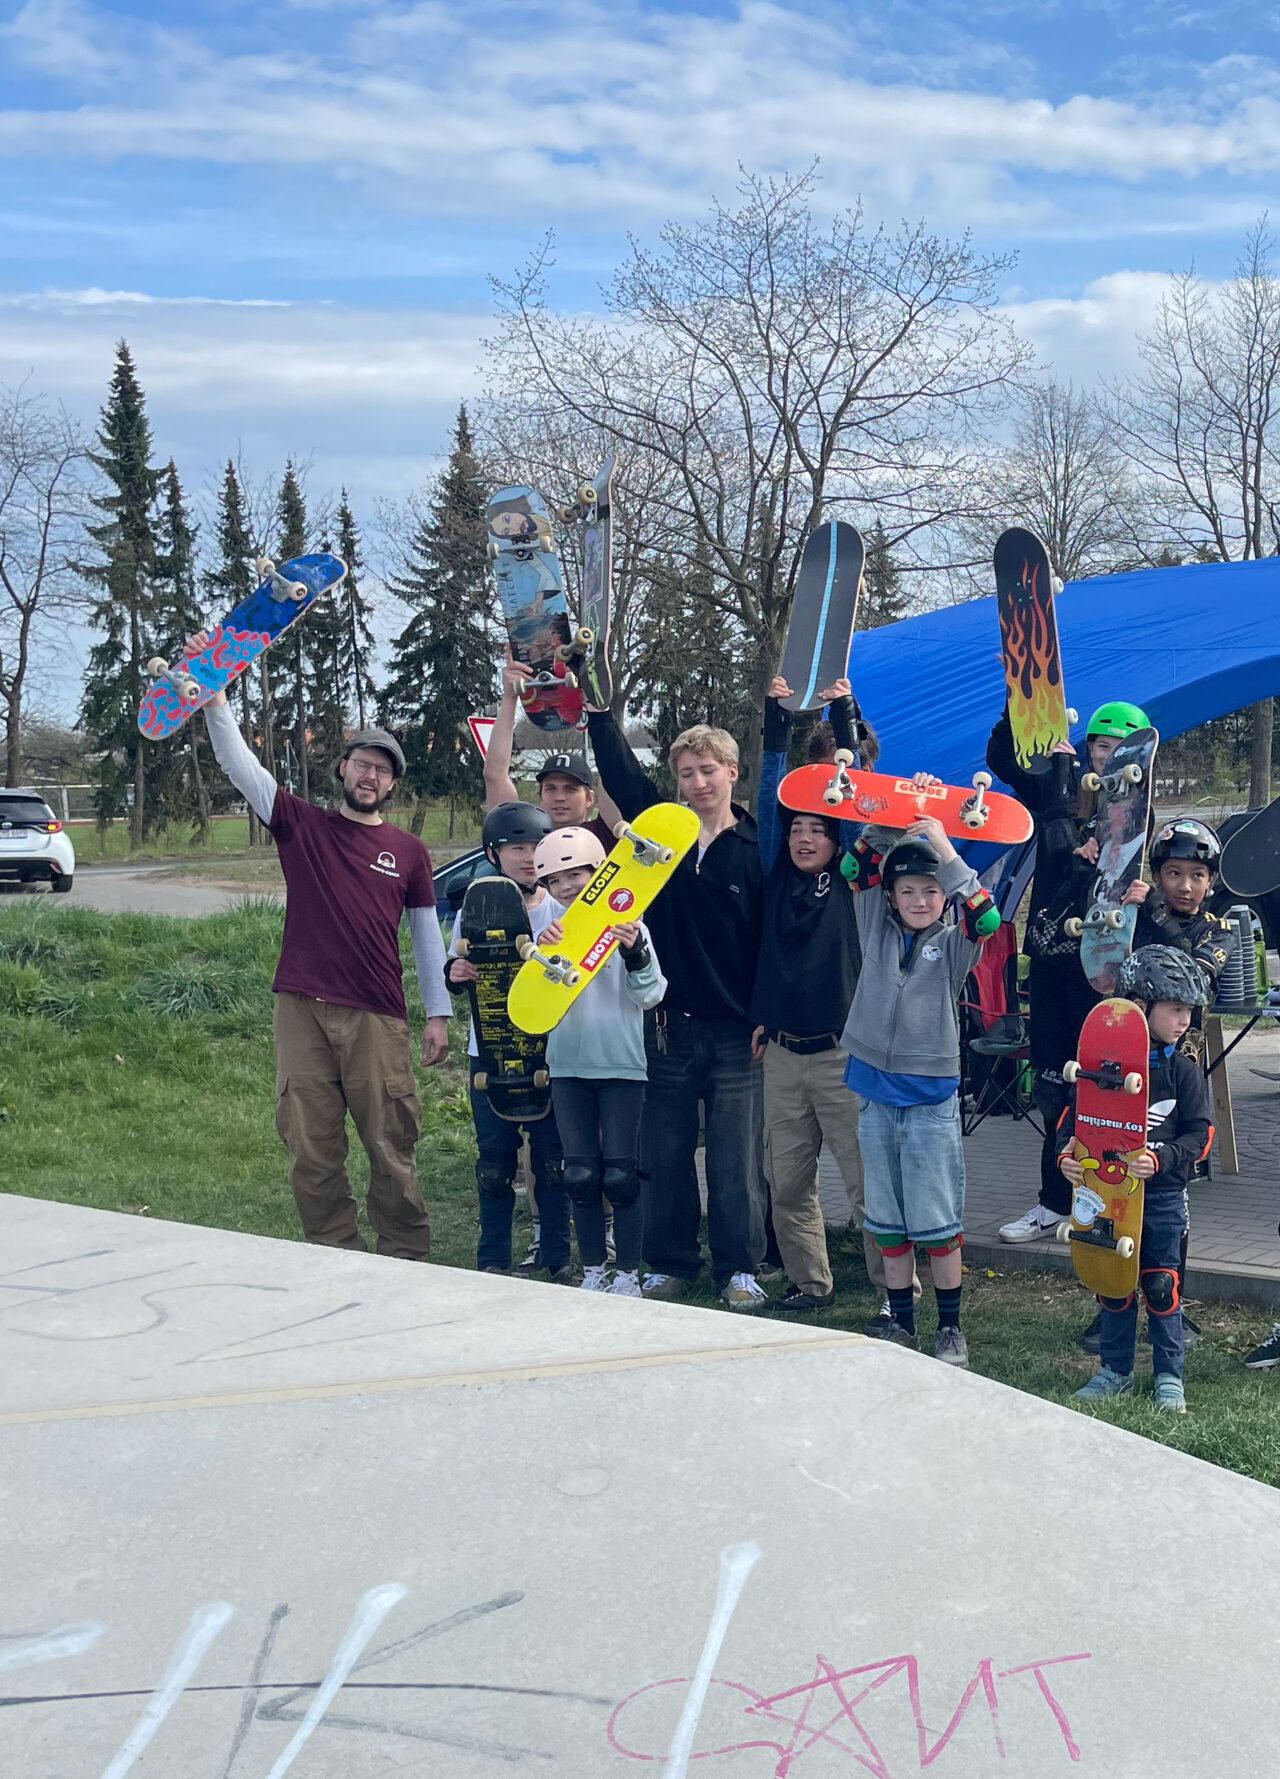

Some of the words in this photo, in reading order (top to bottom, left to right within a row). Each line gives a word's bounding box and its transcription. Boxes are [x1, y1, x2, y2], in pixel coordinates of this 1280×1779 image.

[899, 783, 944, 797] GLOBE
[585, 864, 617, 902] GLOBE
[584, 930, 615, 968] GLOBE
[1077, 1114, 1123, 1128] machine
[1124, 1123, 1144, 1134] toy
